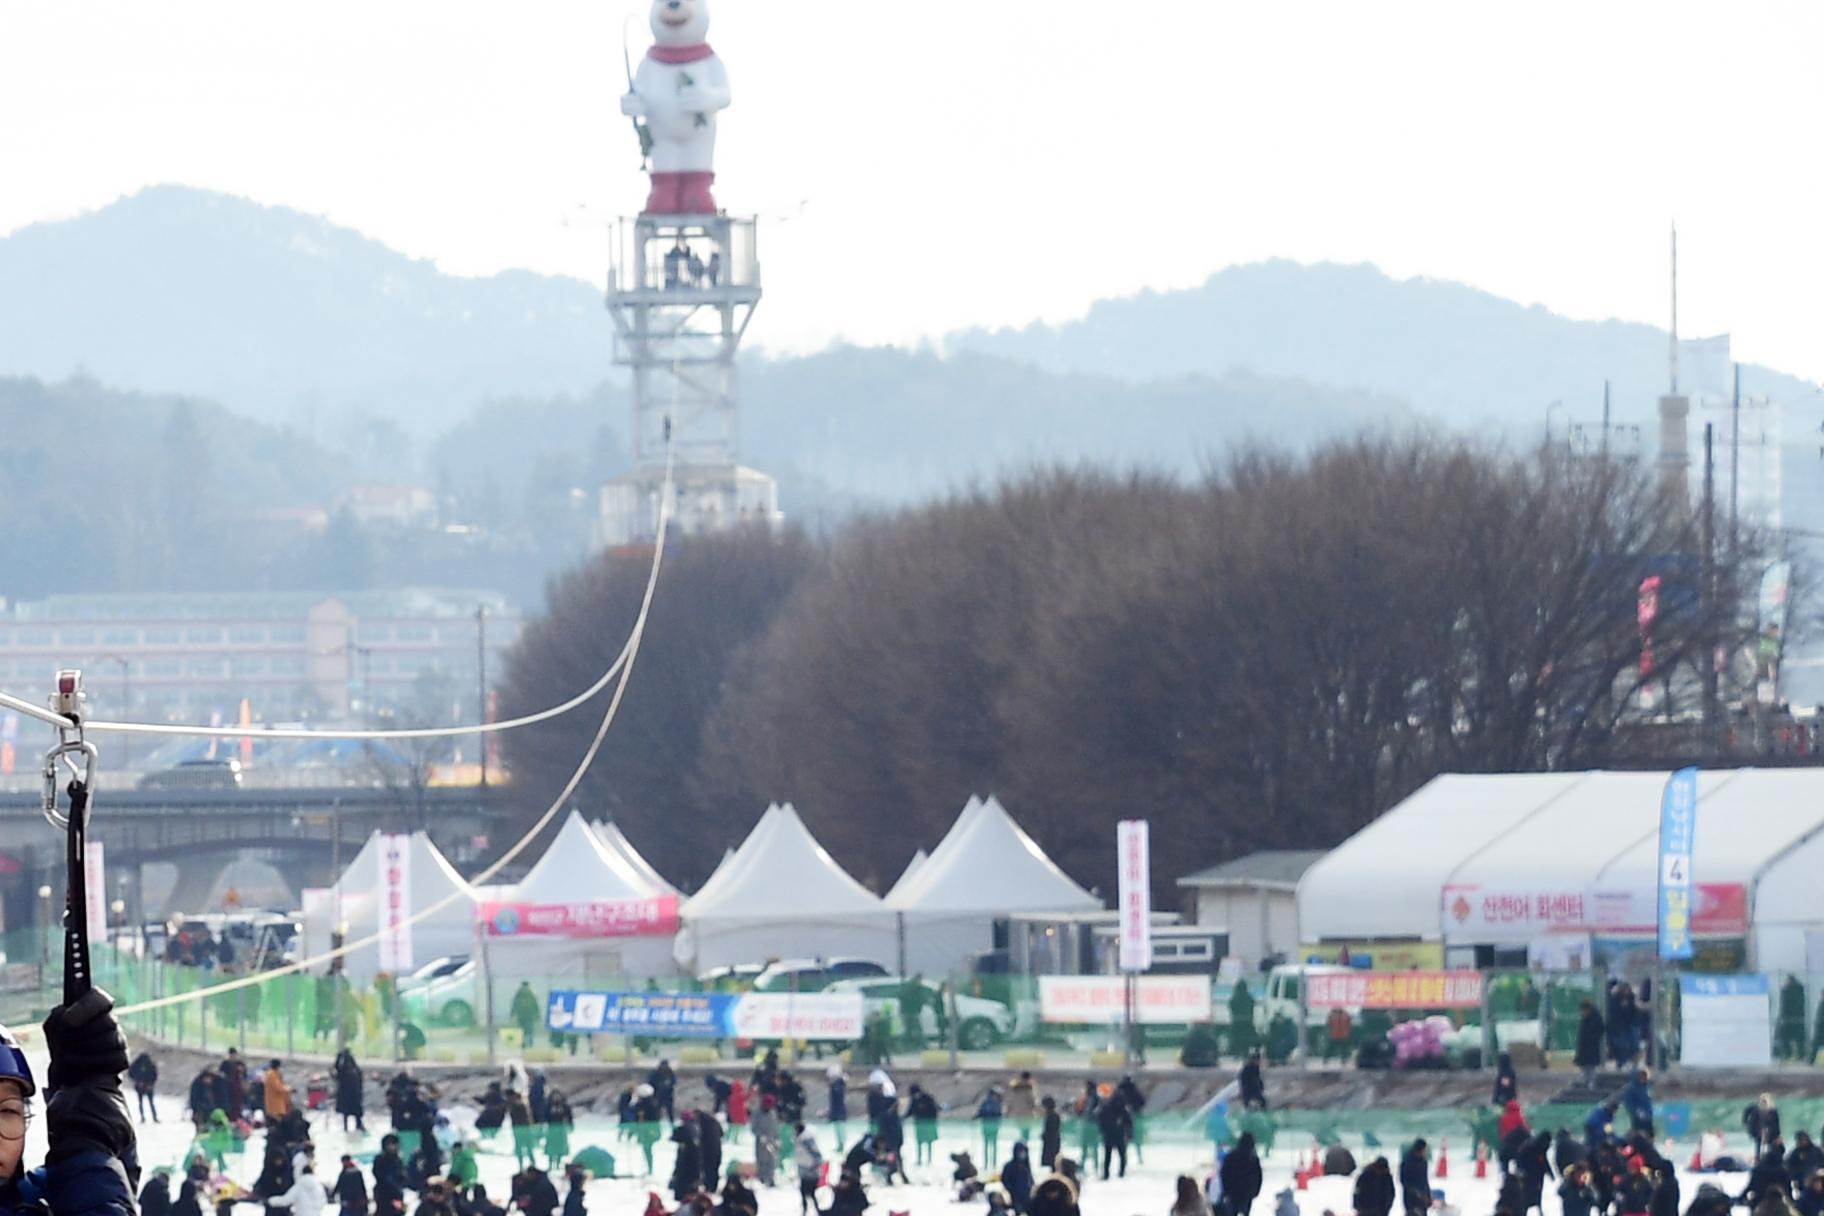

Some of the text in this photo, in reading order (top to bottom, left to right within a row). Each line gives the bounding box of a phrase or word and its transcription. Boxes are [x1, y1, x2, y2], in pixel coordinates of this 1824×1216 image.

[1670, 860, 1683, 881] 4
[1482, 895, 1529, 922] 산천어
[1536, 895, 1583, 923] 회센터
